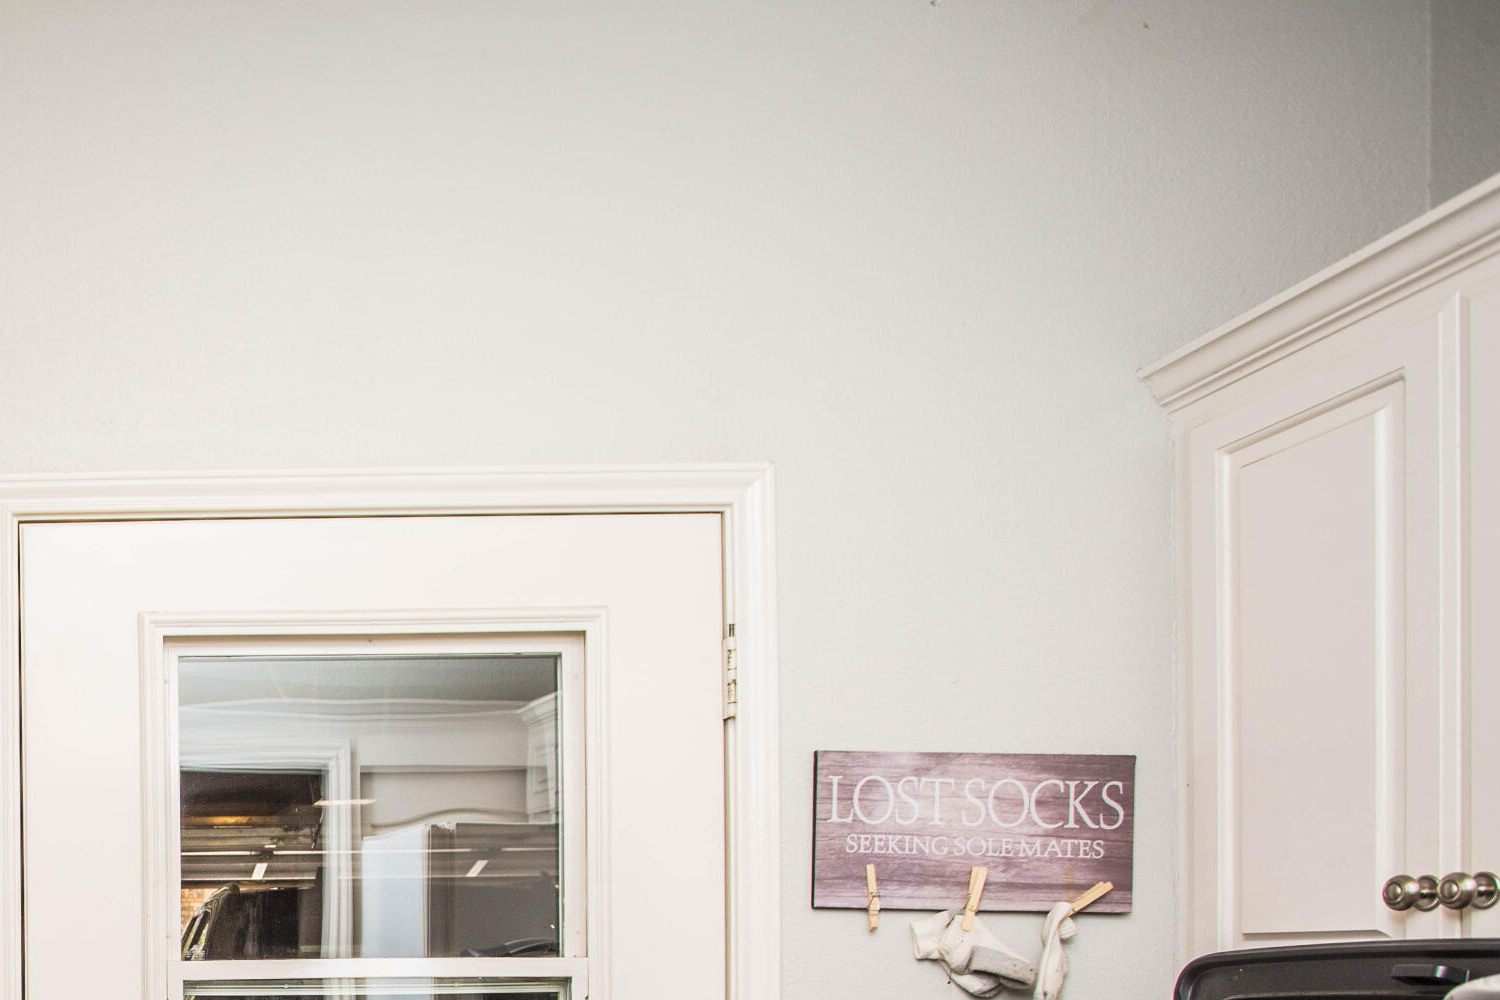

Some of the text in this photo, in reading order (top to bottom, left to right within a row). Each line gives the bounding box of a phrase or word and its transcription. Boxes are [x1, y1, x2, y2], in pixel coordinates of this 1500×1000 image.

[827, 775, 1125, 829] LOST SOCKS
[845, 834, 1105, 859] SEEKING SOLE MATES
